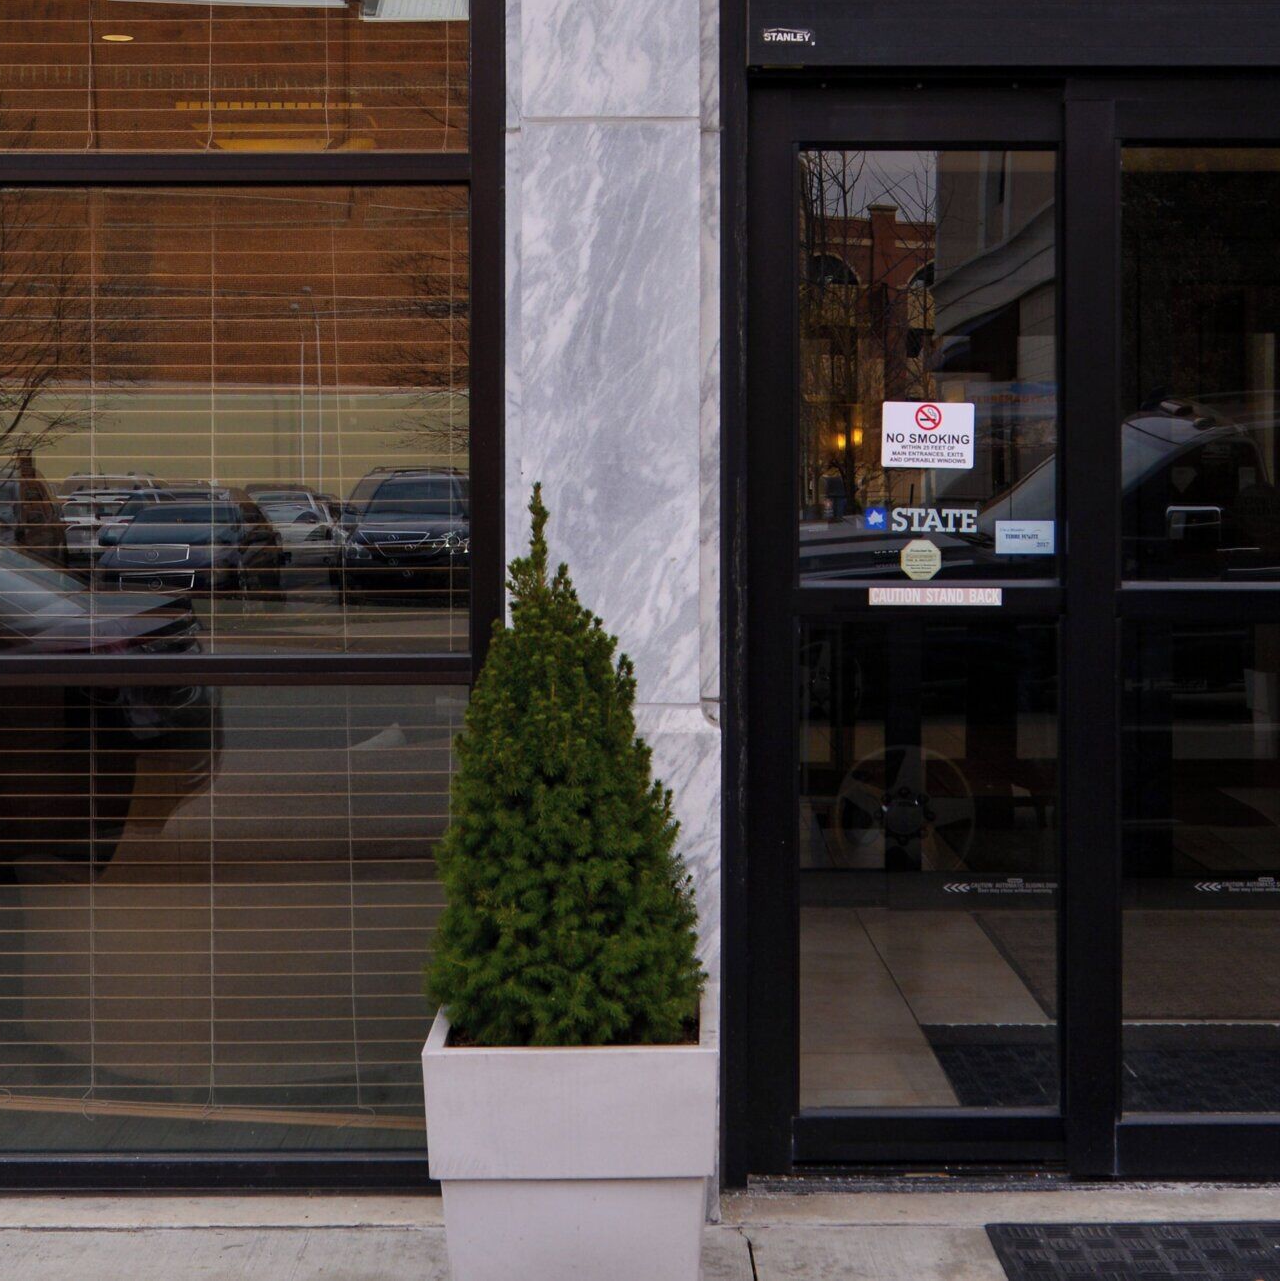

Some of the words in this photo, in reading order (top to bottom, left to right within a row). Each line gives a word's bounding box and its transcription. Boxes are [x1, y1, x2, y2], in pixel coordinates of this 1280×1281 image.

[763, 33, 810, 41] STANLEY
[887, 433, 904, 443] NO
[909, 434, 970, 444] SMOKING
[892, 507, 978, 532] STATE
[872, 589, 920, 603] CAUTION
[926, 589, 964, 603] STAND
[969, 589, 1000, 603] BACK
